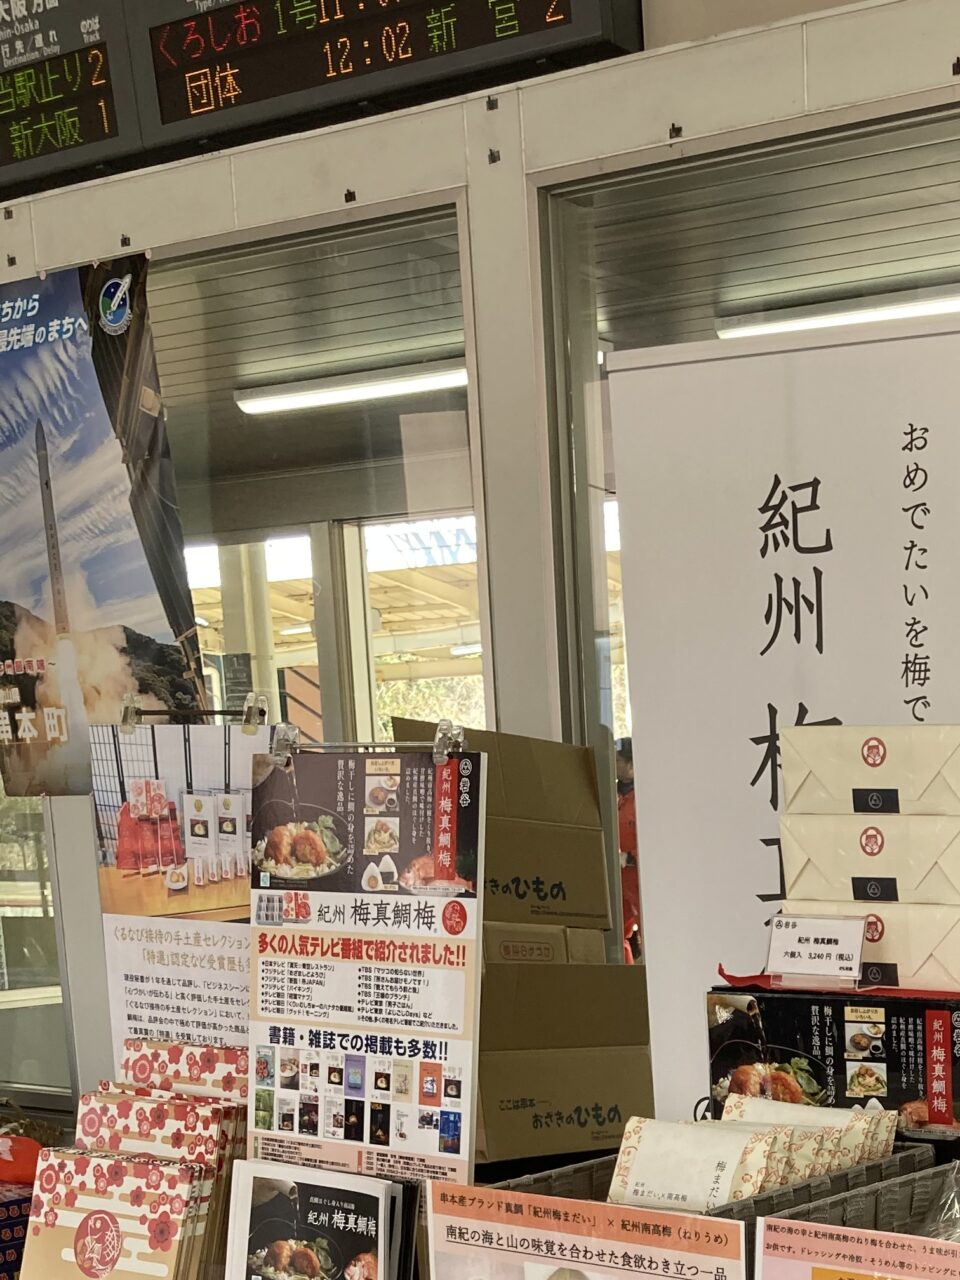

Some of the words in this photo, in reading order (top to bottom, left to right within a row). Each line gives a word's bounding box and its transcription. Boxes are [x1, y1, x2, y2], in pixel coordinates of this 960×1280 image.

[88, 49, 106, 86] 2
[159, 5, 262, 67] くろしお
[185, 62, 243, 114] 団体
[323, 22, 413, 77] 12:02
[9, 106, 84, 159] 新大阪
[758, 473, 833, 657] 紀州
[900, 422, 932, 723] おめでたいを梅で
[316, 904, 346, 926] 紀州
[930, 1046, 948, 1113] 梅真鯛梅
